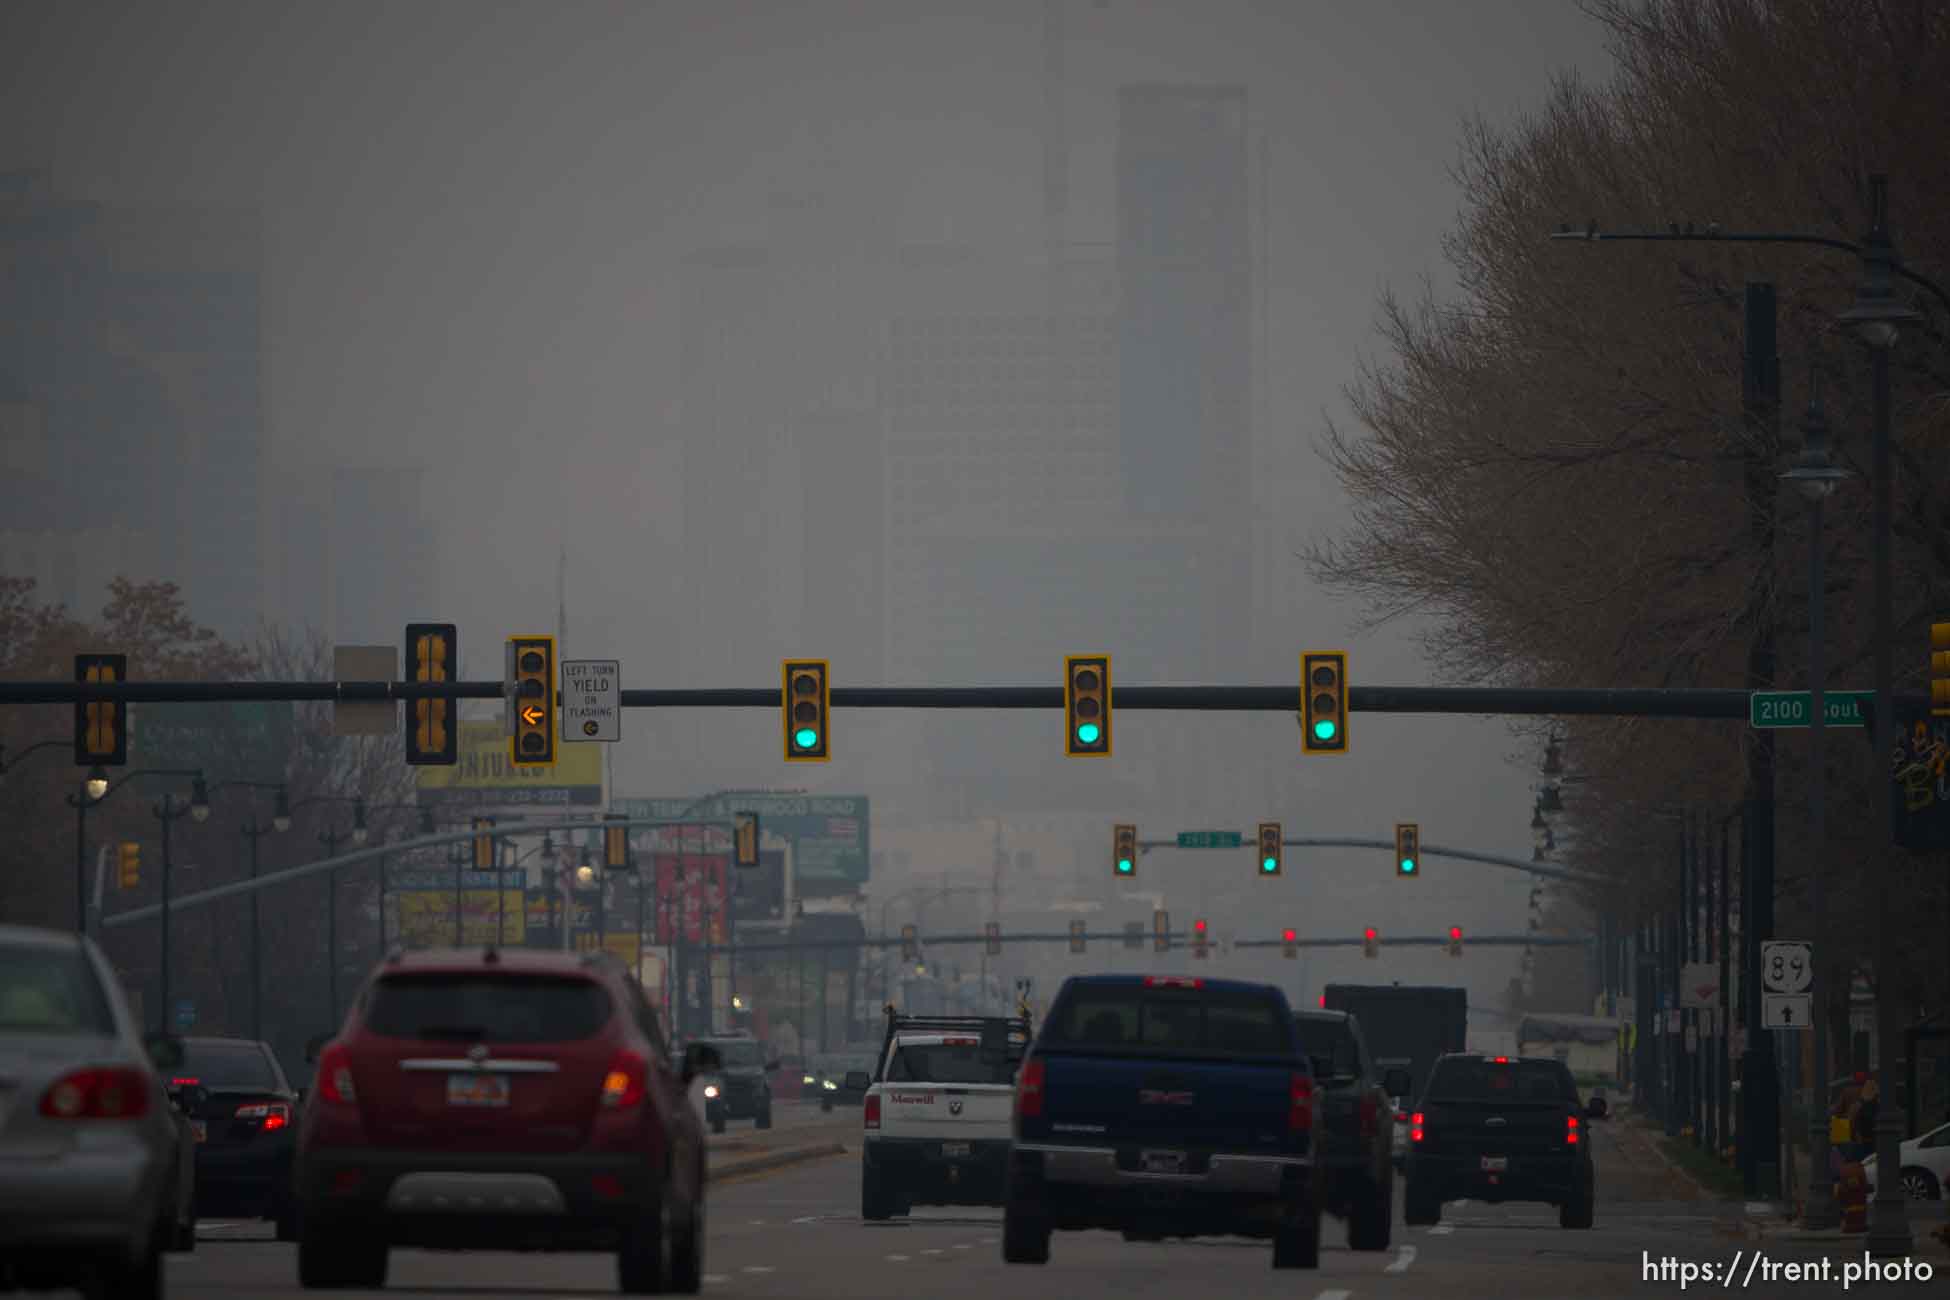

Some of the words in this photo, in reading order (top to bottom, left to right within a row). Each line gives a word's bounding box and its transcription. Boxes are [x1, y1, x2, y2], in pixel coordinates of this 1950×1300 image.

[566, 665, 587, 676] LEFT
[592, 665, 615, 675] TURN
[573, 679, 609, 692] YIELD
[584, 695, 597, 705] ON
[1761, 701, 1802, 719] 2100
[1773, 956, 1803, 981] 89
